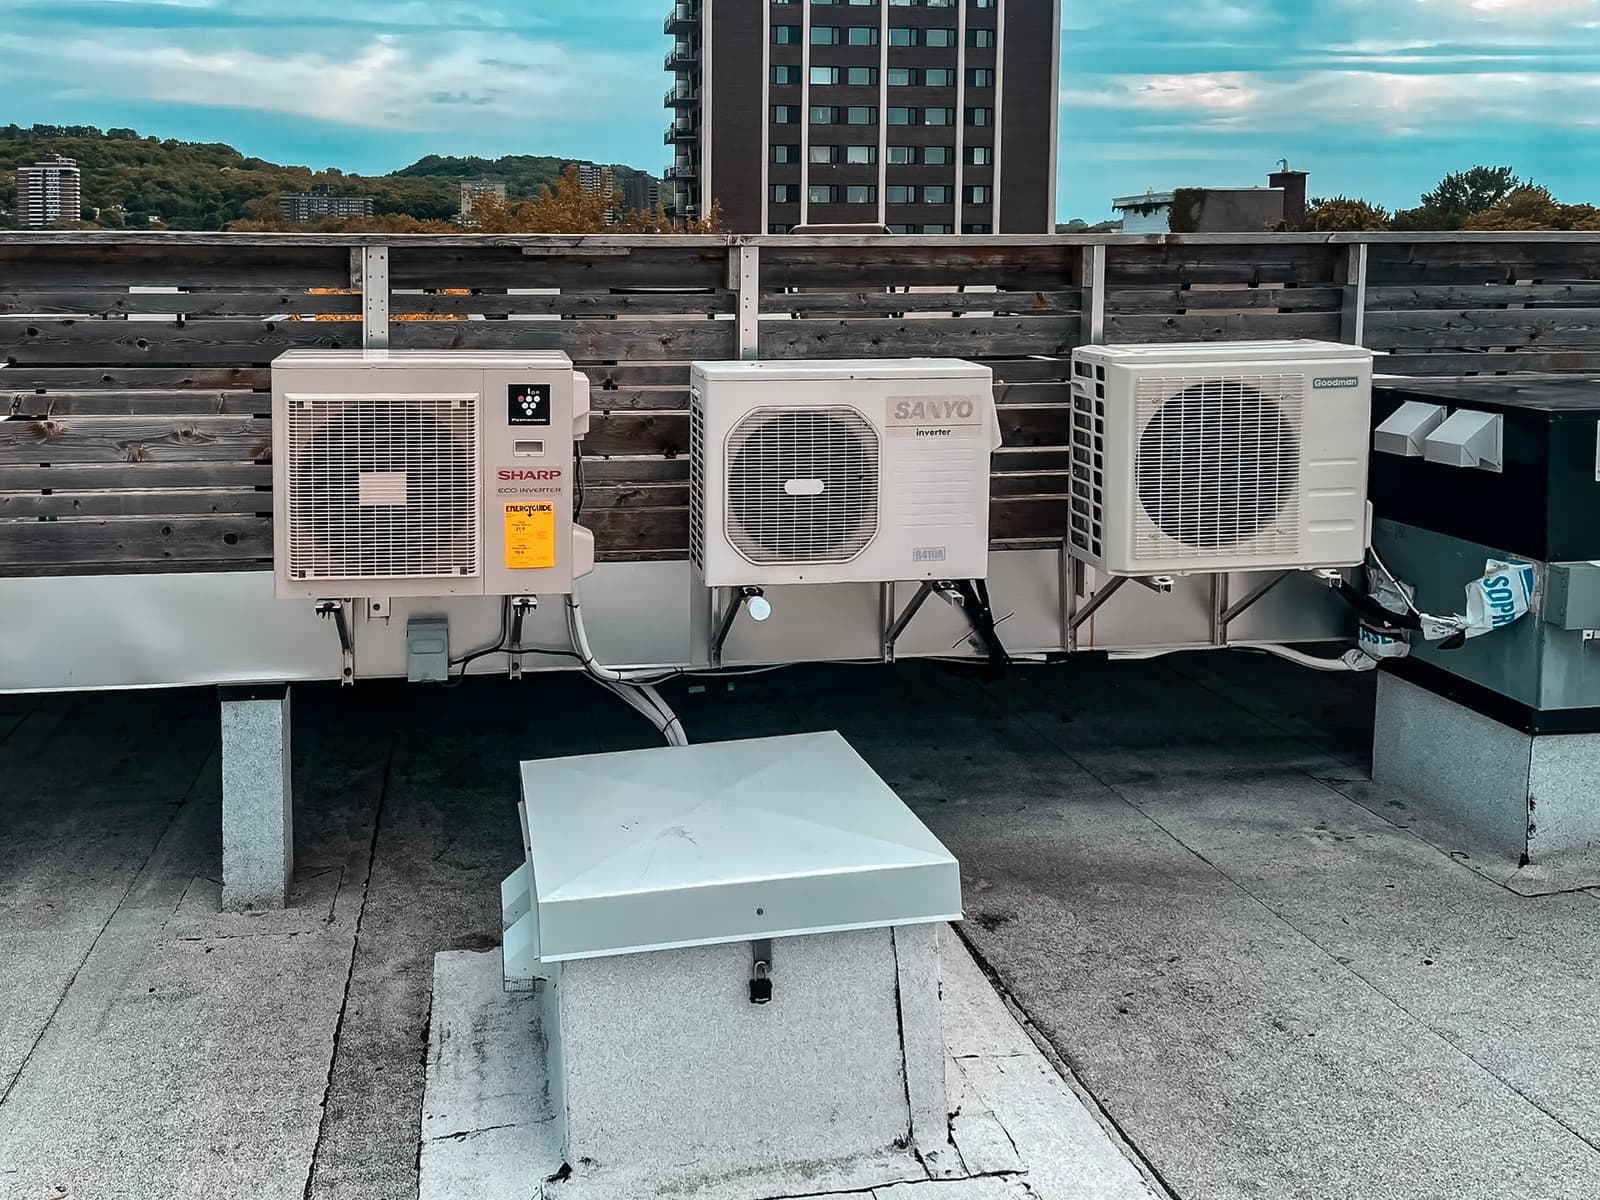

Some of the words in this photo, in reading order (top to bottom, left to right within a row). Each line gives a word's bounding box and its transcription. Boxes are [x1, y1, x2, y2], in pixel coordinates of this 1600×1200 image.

[1313, 378, 1357, 388] Goodman
[894, 400, 974, 419] SANYO
[916, 428, 951, 436] inverter
[498, 470, 561, 480] SHARP
[1482, 575, 1516, 629] SOPR
